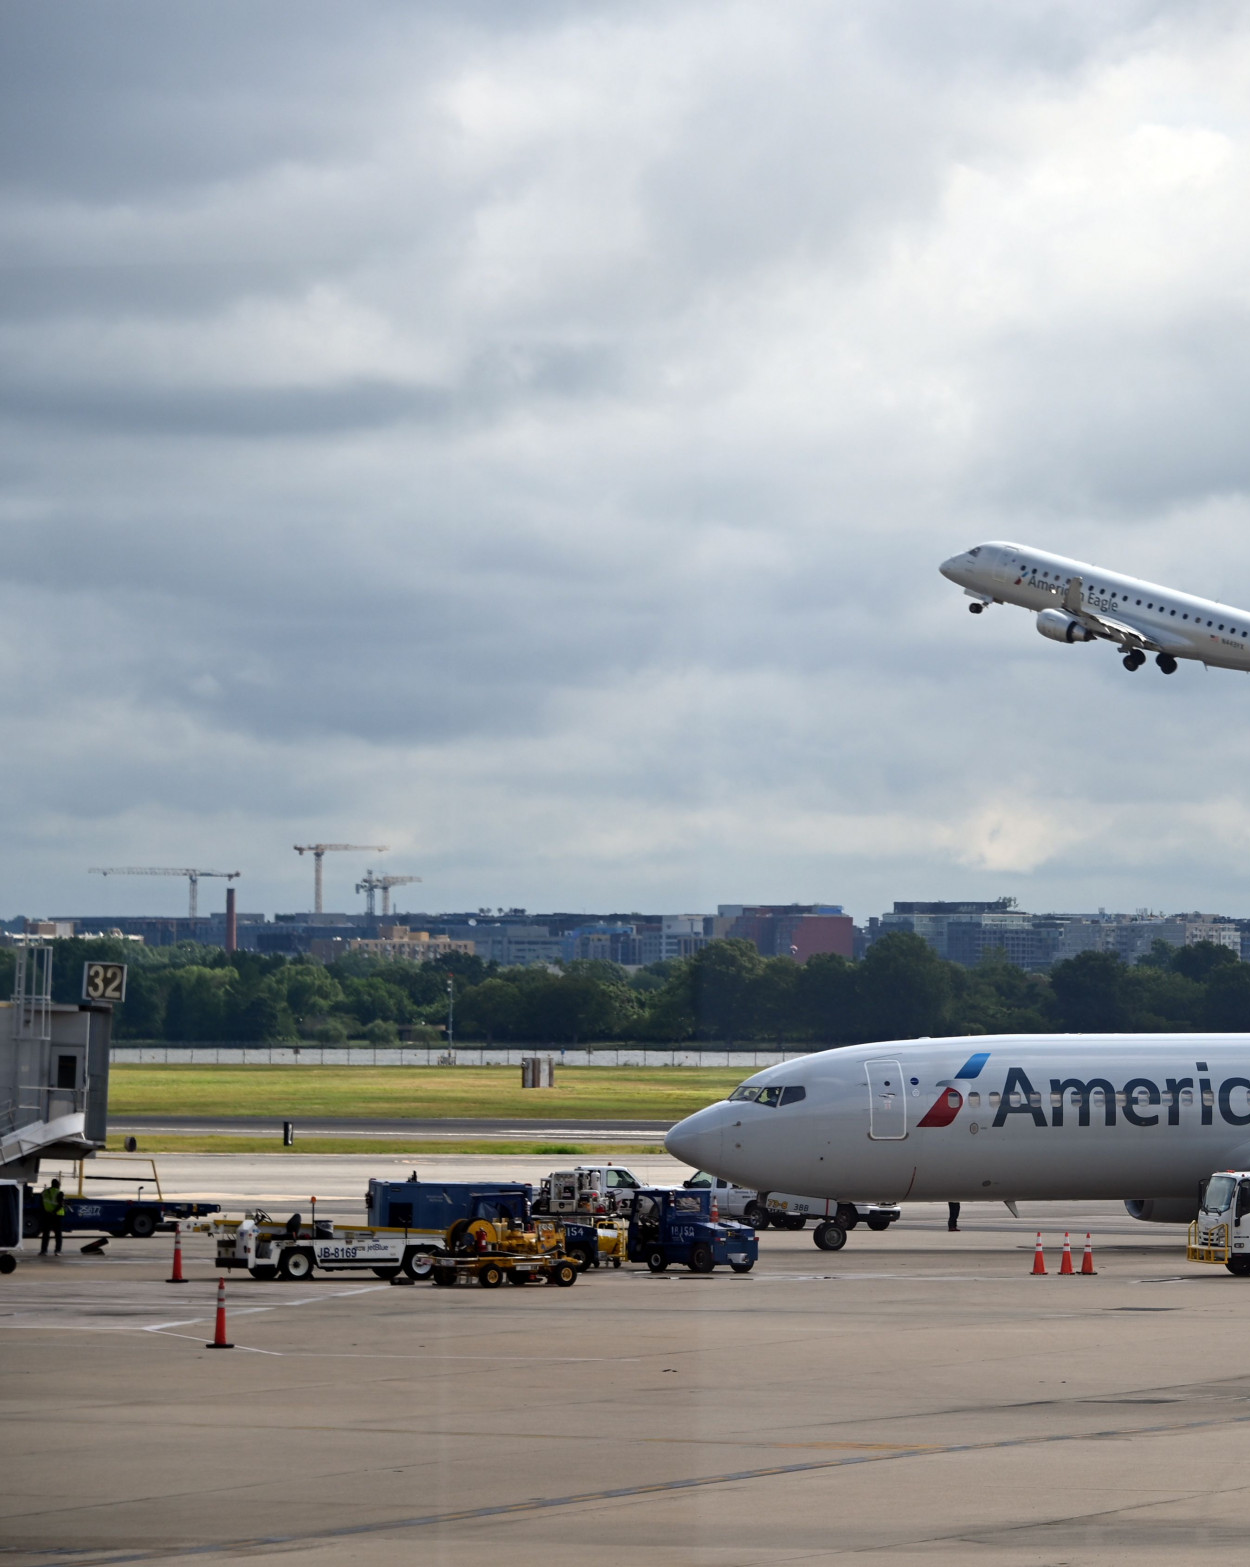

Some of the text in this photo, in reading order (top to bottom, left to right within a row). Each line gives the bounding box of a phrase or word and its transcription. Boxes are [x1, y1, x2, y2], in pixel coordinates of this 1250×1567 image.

[1028, 575, 1118, 613] Americn Eagle
[88, 965, 122, 998] 32
[318, 1247, 357, 1258] JB-8169
[367, 1244, 389, 1253] jetBlue
